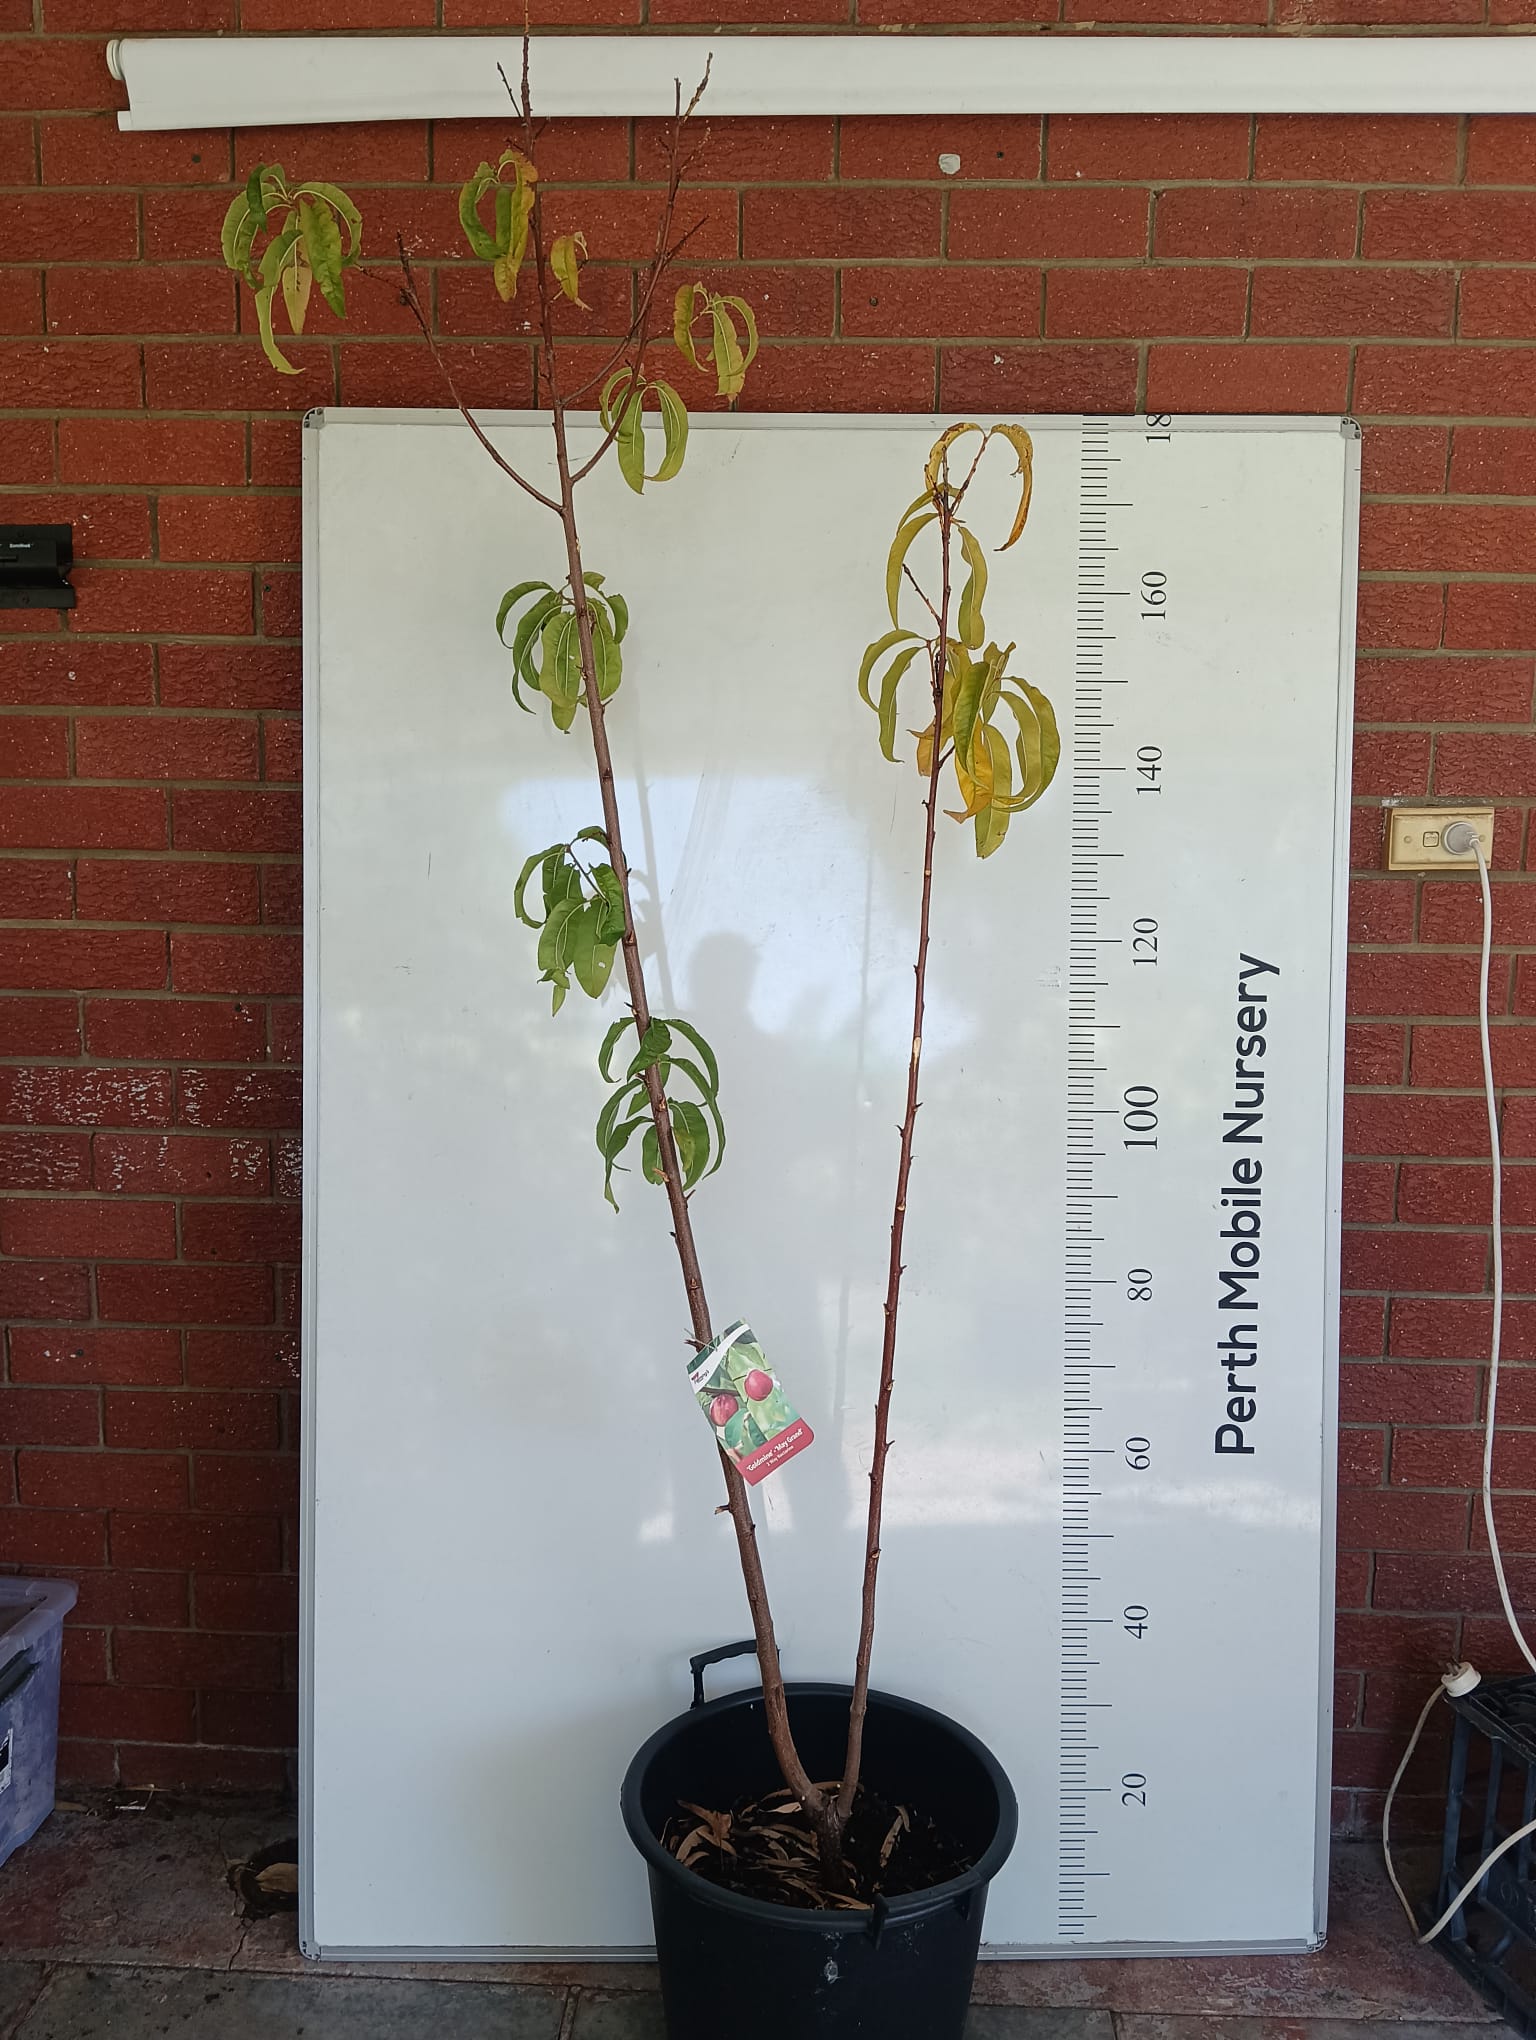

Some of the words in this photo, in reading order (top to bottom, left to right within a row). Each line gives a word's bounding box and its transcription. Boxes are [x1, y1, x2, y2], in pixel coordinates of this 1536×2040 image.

[1140, 571, 1168, 621] 160
[1135, 745, 1163, 795] 140
[1132, 917, 1159, 966] 120
[1221, 952, 1281, 1144] Nursery
[1123, 1085, 1159, 1151] 100
[1217, 1157, 1263, 1311] Mobile
[1126, 1268, 1153, 1302] 80
[1214, 1324, 1258, 1455] Perth
[1124, 1436, 1151, 1471] 60
[1123, 1605, 1149, 1640] 40
[1121, 1773, 1147, 1808] 20
